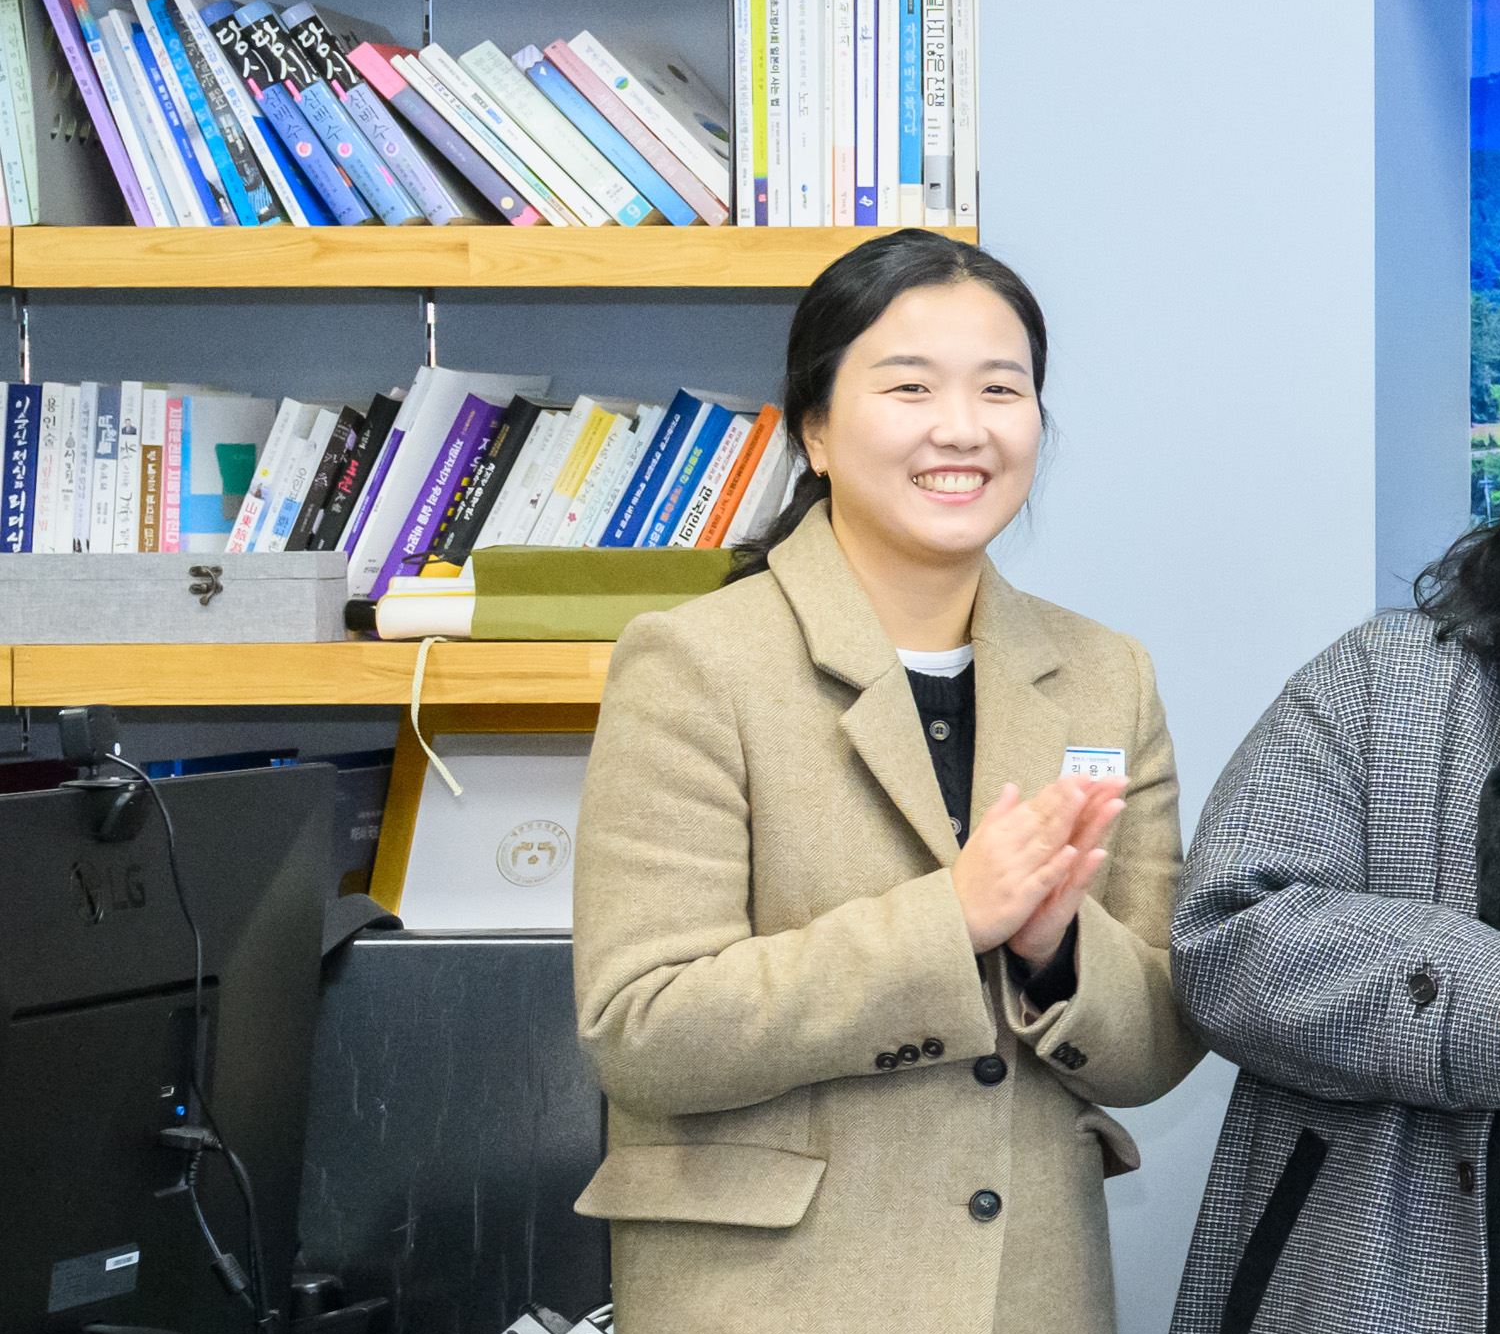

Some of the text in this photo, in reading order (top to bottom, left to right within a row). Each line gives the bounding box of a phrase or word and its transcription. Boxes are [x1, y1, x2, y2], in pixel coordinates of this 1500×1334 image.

[769, 46, 780, 73] 일본이
[926, 42, 944, 72] 않은
[769, 76, 780, 94] 사는
[926, 76, 944, 106] 전쟁
[769, 97, 780, 107] 법
[403, 436, 464, 555] 지방자치가 우리 삶을 바꾼다
[7, 490, 26, 553] 리더십
[679, 484, 713, 542] 한국인의
